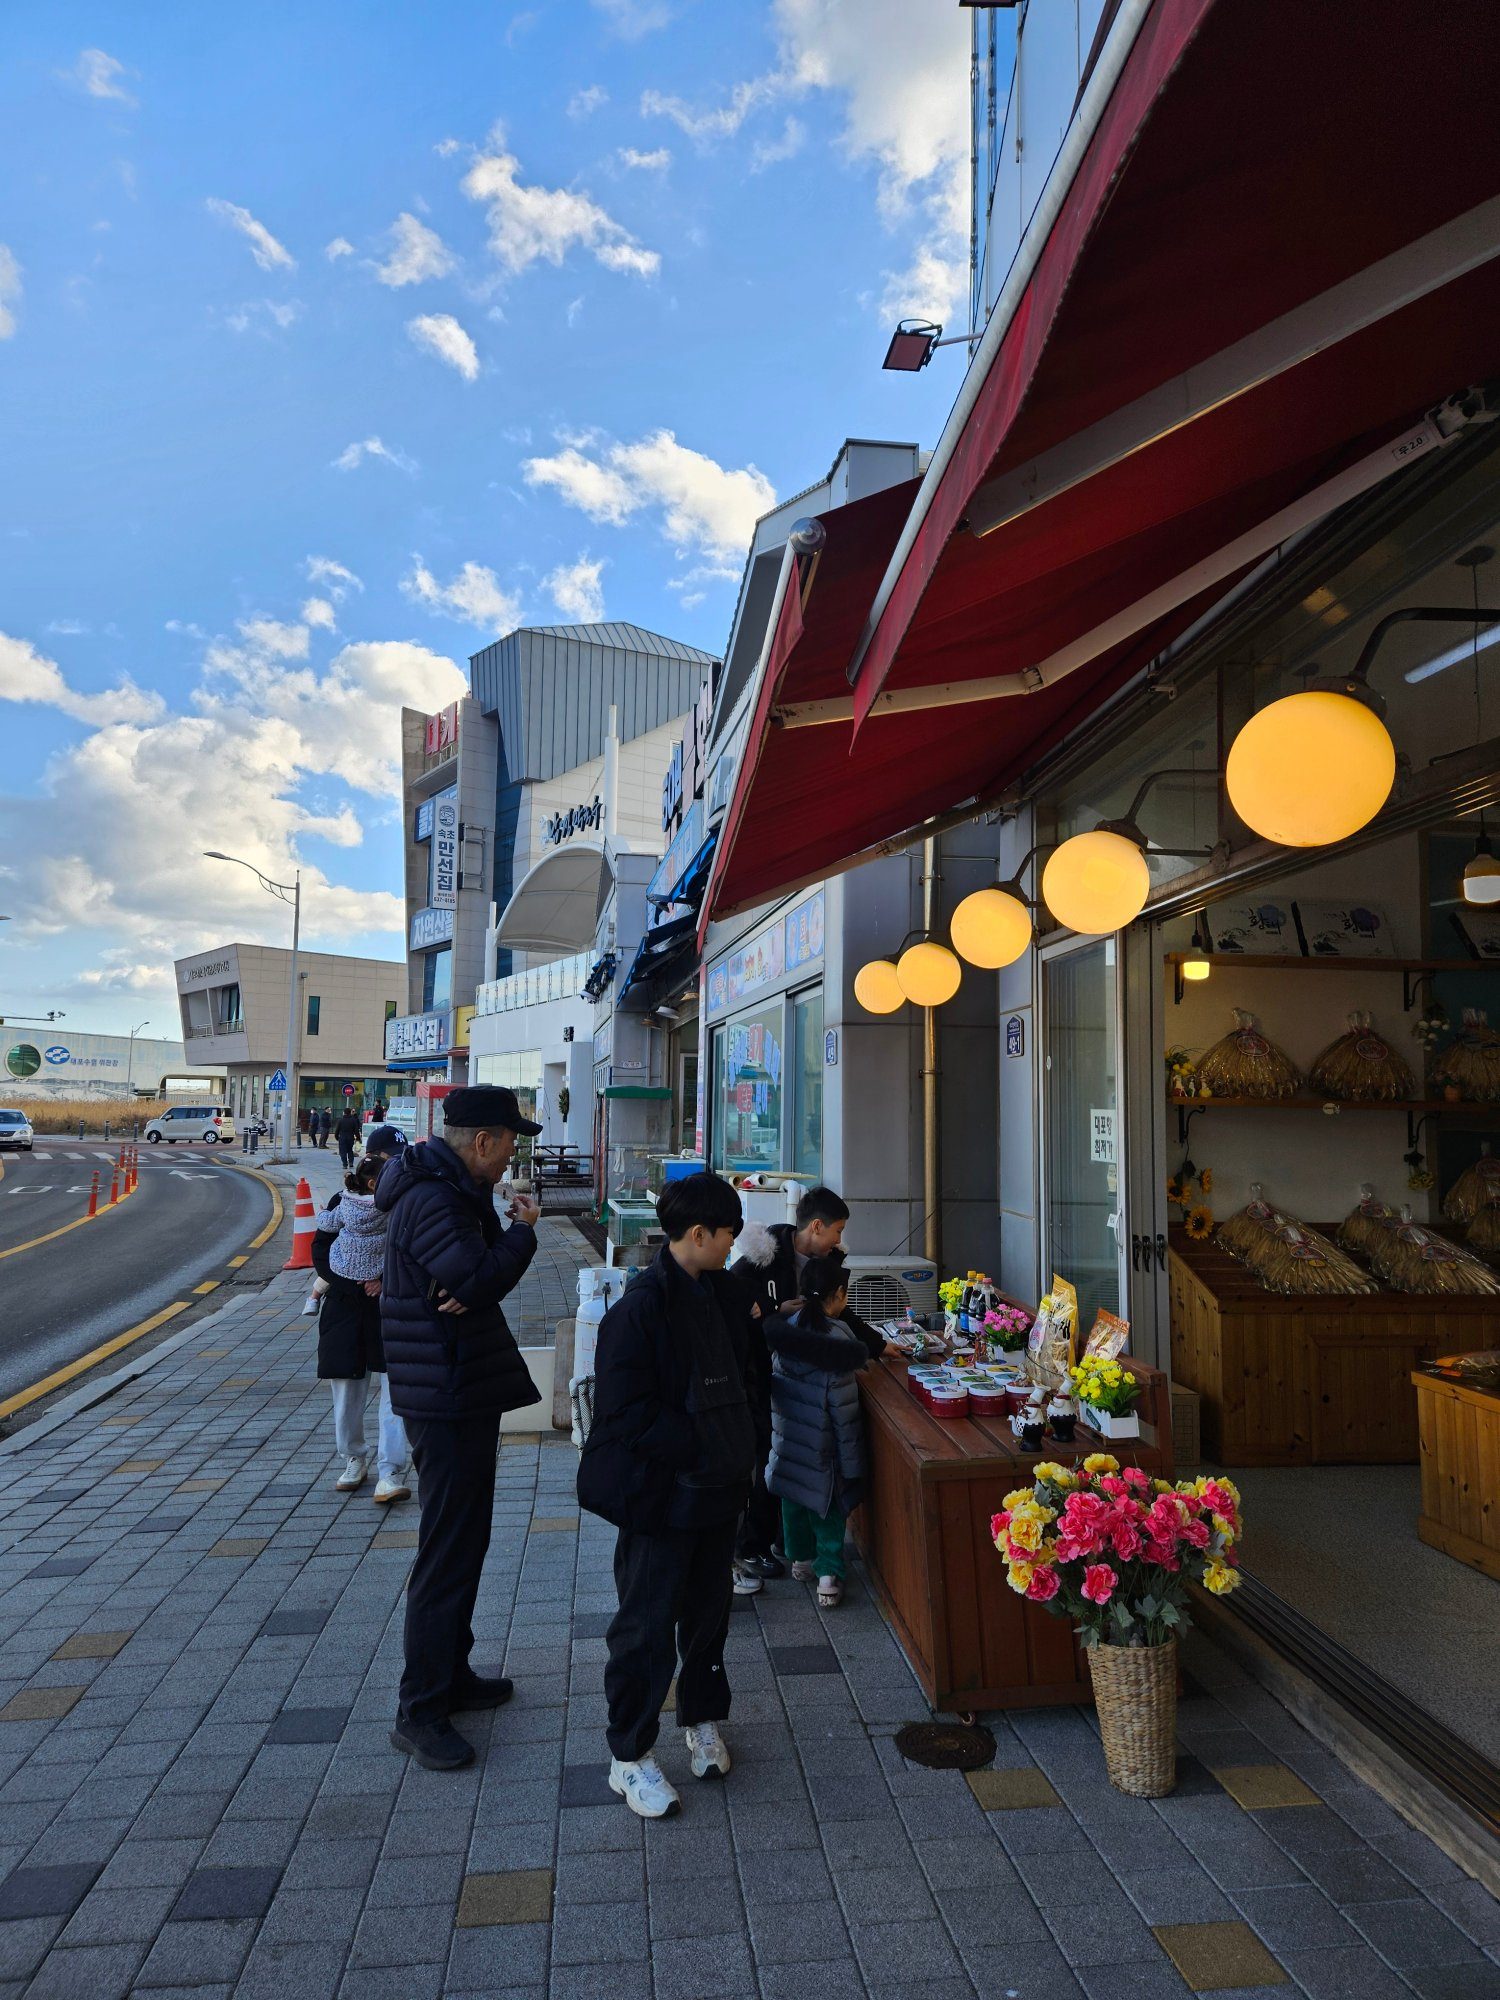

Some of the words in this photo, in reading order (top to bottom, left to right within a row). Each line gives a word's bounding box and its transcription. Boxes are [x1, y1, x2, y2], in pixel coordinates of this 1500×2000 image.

[437, 829, 455, 840] 속초
[437, 840, 453, 892] 만선집
[1008, 1035, 1020, 1052] 49-1
[70, 1058, 97, 1067] 대포수협
[99, 1058, 119, 1067] 위판장
[1094, 1115, 1113, 1137] 대포항
[1094, 1138, 1113, 1160] 최저가
